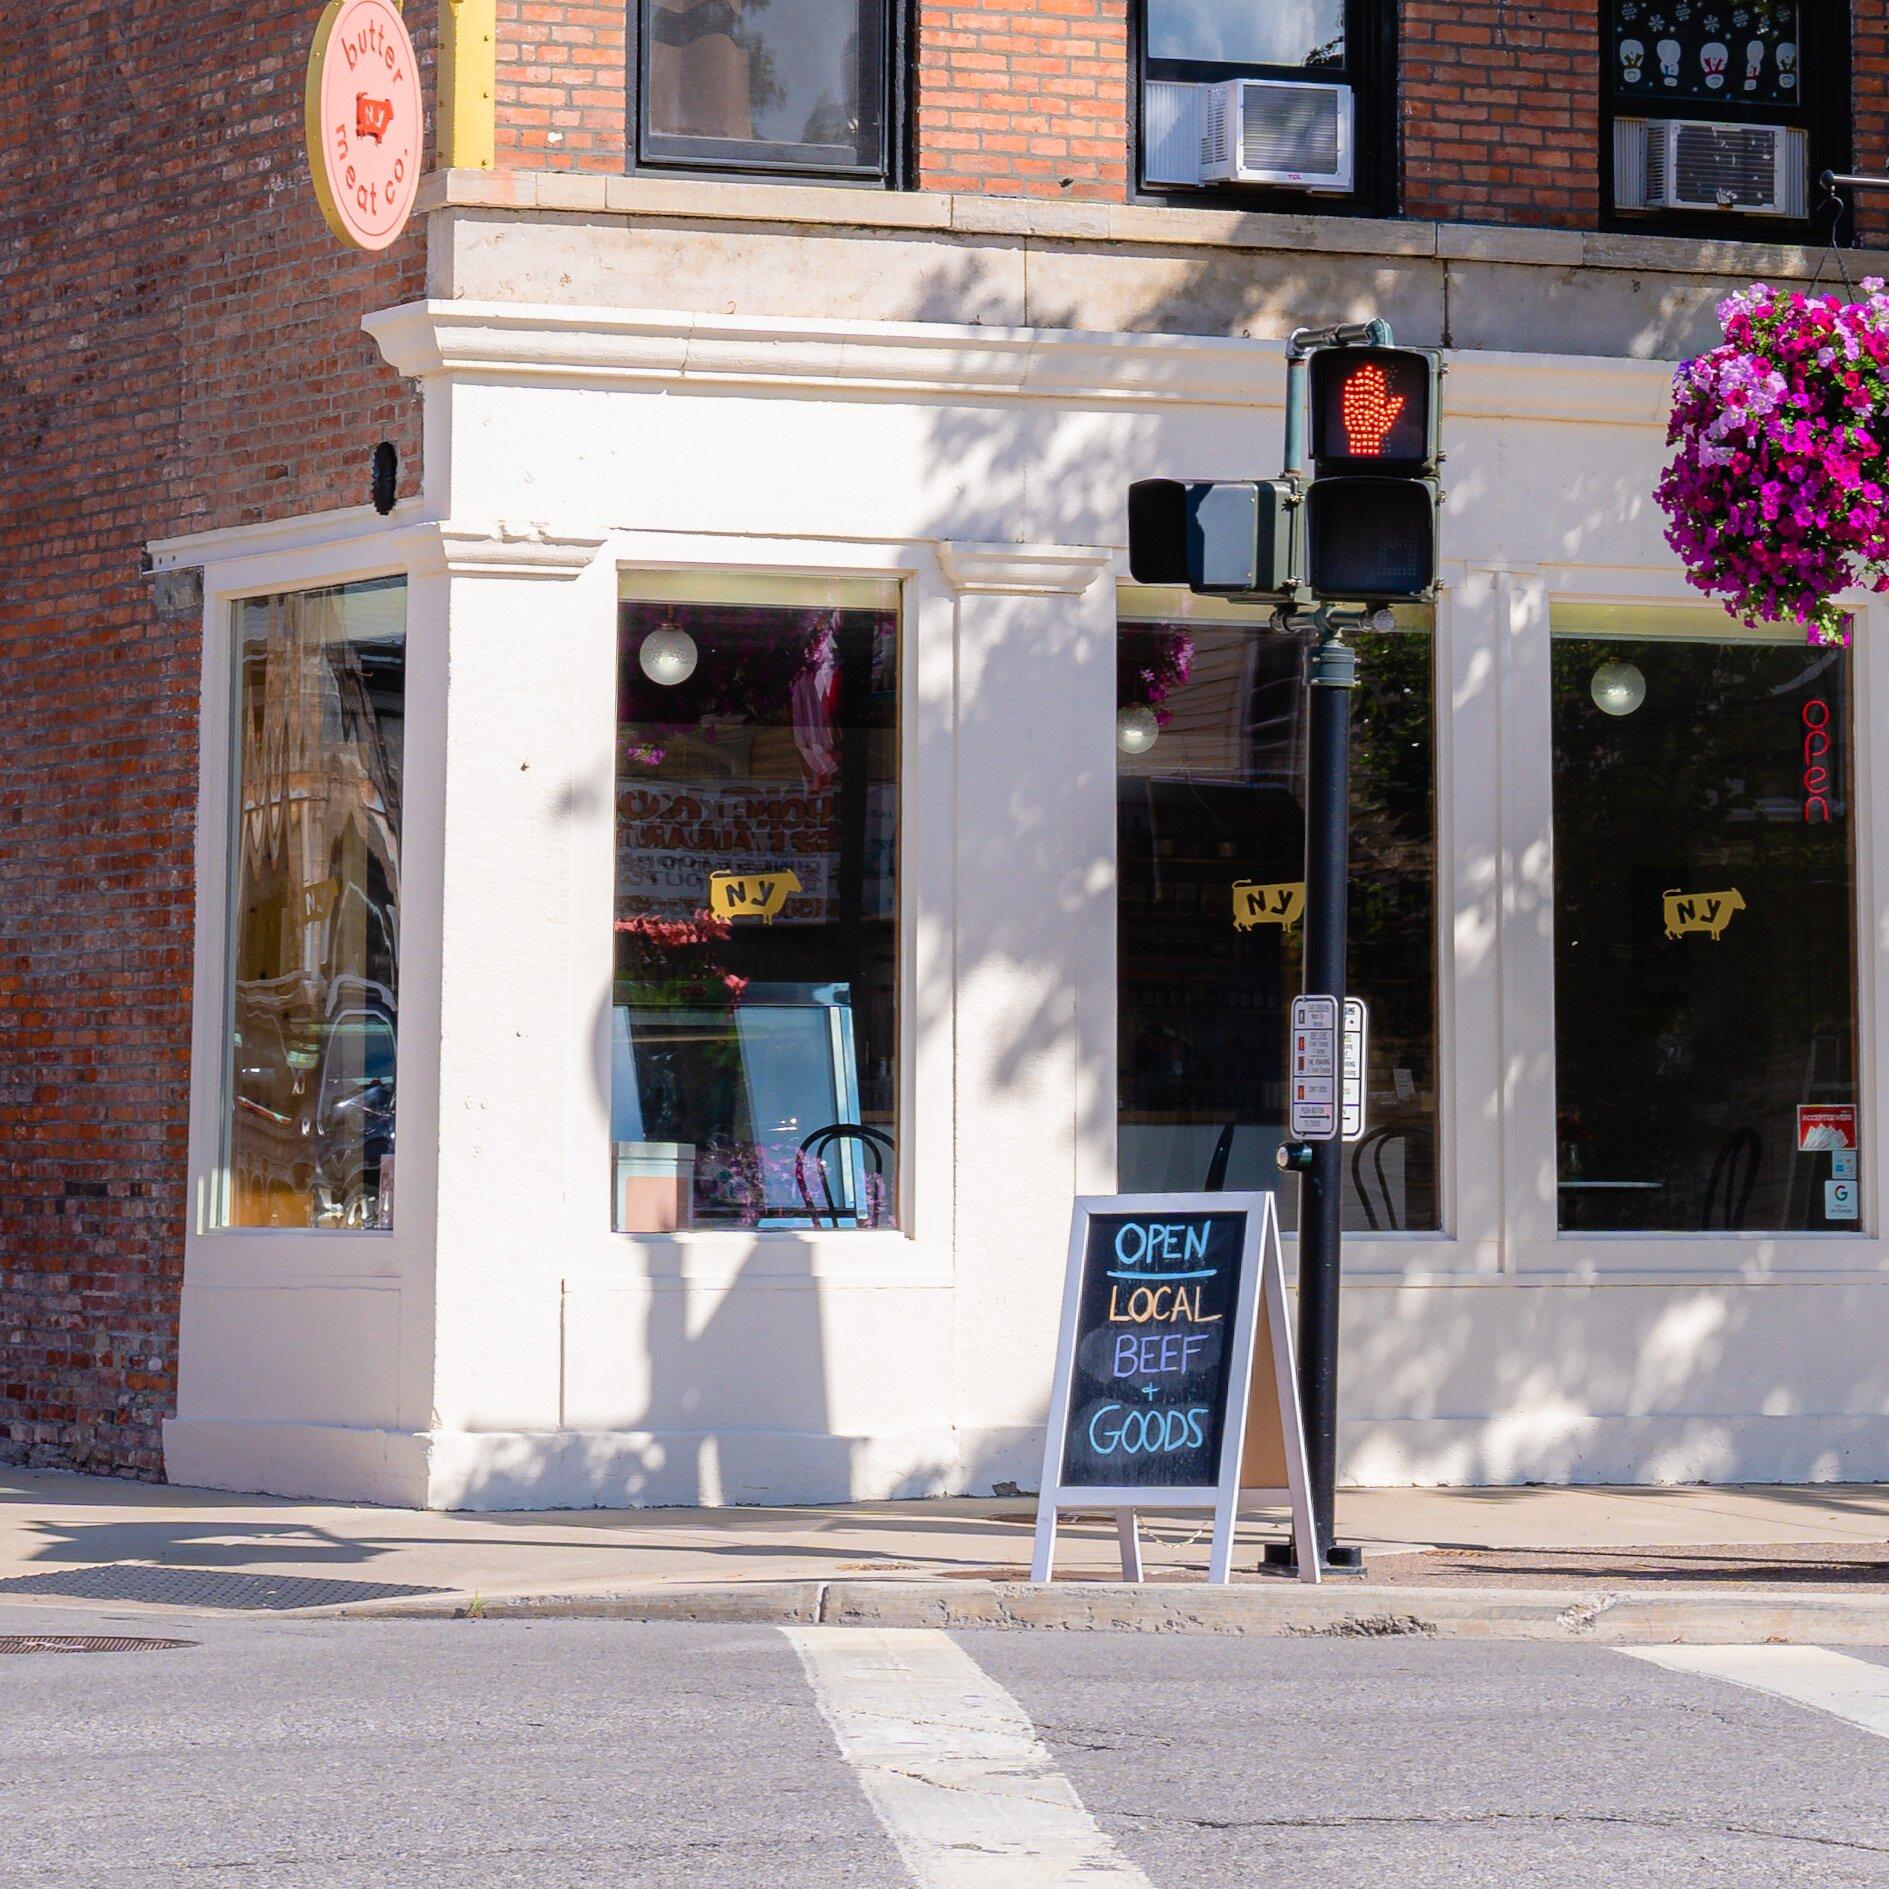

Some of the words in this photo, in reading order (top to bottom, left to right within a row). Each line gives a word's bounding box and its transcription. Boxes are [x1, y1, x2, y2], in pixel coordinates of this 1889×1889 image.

[341, 19, 404, 84] butter
[335, 123, 378, 217] meat
[384, 148, 409, 205] co.
[1834, 1184, 1848, 1202] G
[1114, 1219, 1212, 1265] OPEN
[1109, 1285, 1223, 1323] LOCAL
[1113, 1334, 1210, 1378] BEEF
[1141, 1381, 1161, 1402] +
[1088, 1404, 1210, 1455] GOODS
